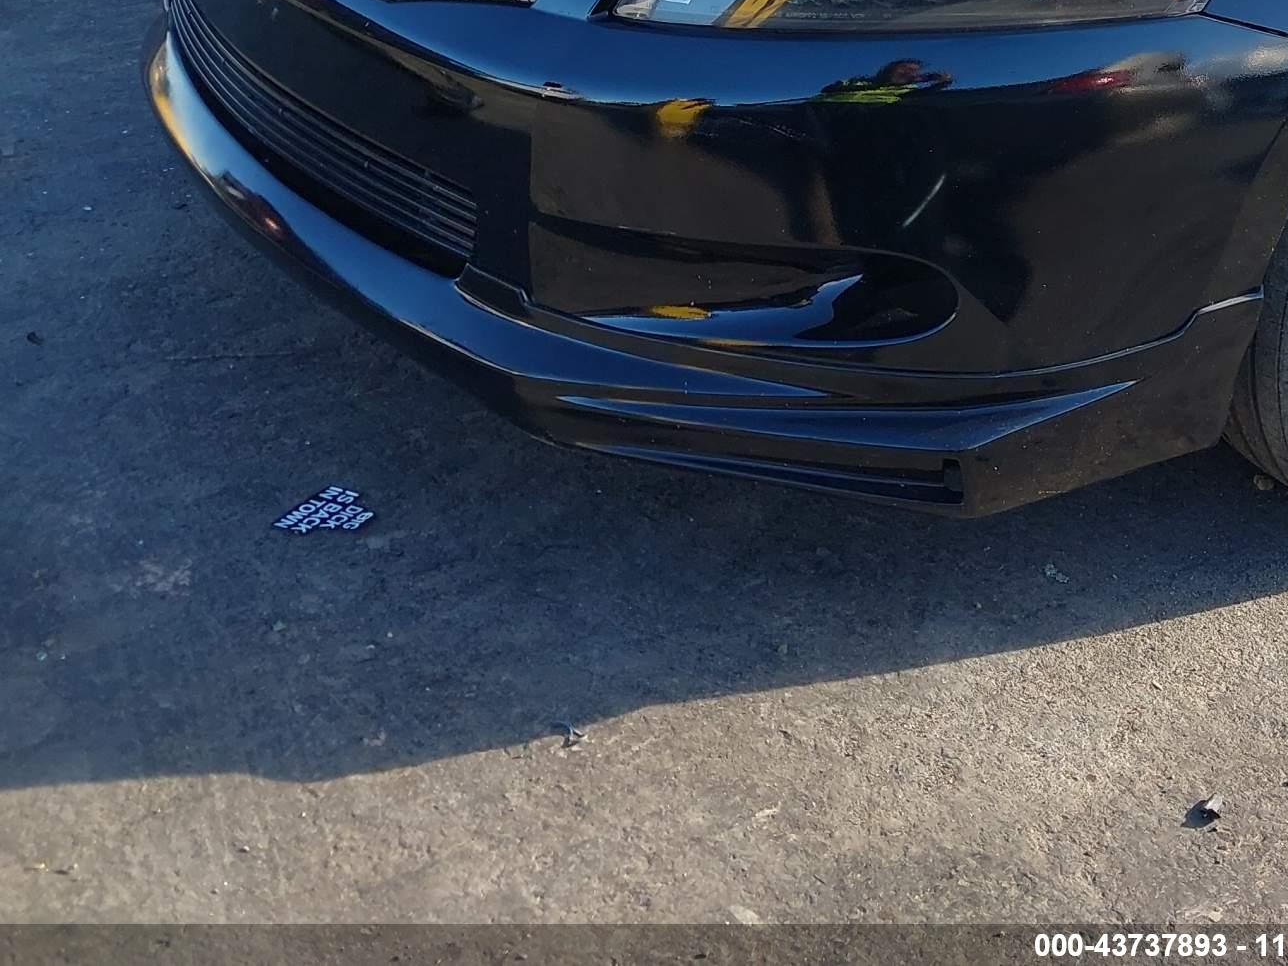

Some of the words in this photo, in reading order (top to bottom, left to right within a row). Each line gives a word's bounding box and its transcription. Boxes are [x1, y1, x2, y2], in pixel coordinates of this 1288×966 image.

[319, 486, 344, 500] IN
[336, 490, 360, 504] IS
[273, 499, 327, 529] TOWN
[290, 502, 343, 533] BACK
[319, 504, 364, 529] DICK
[342, 511, 374, 530] BIG
